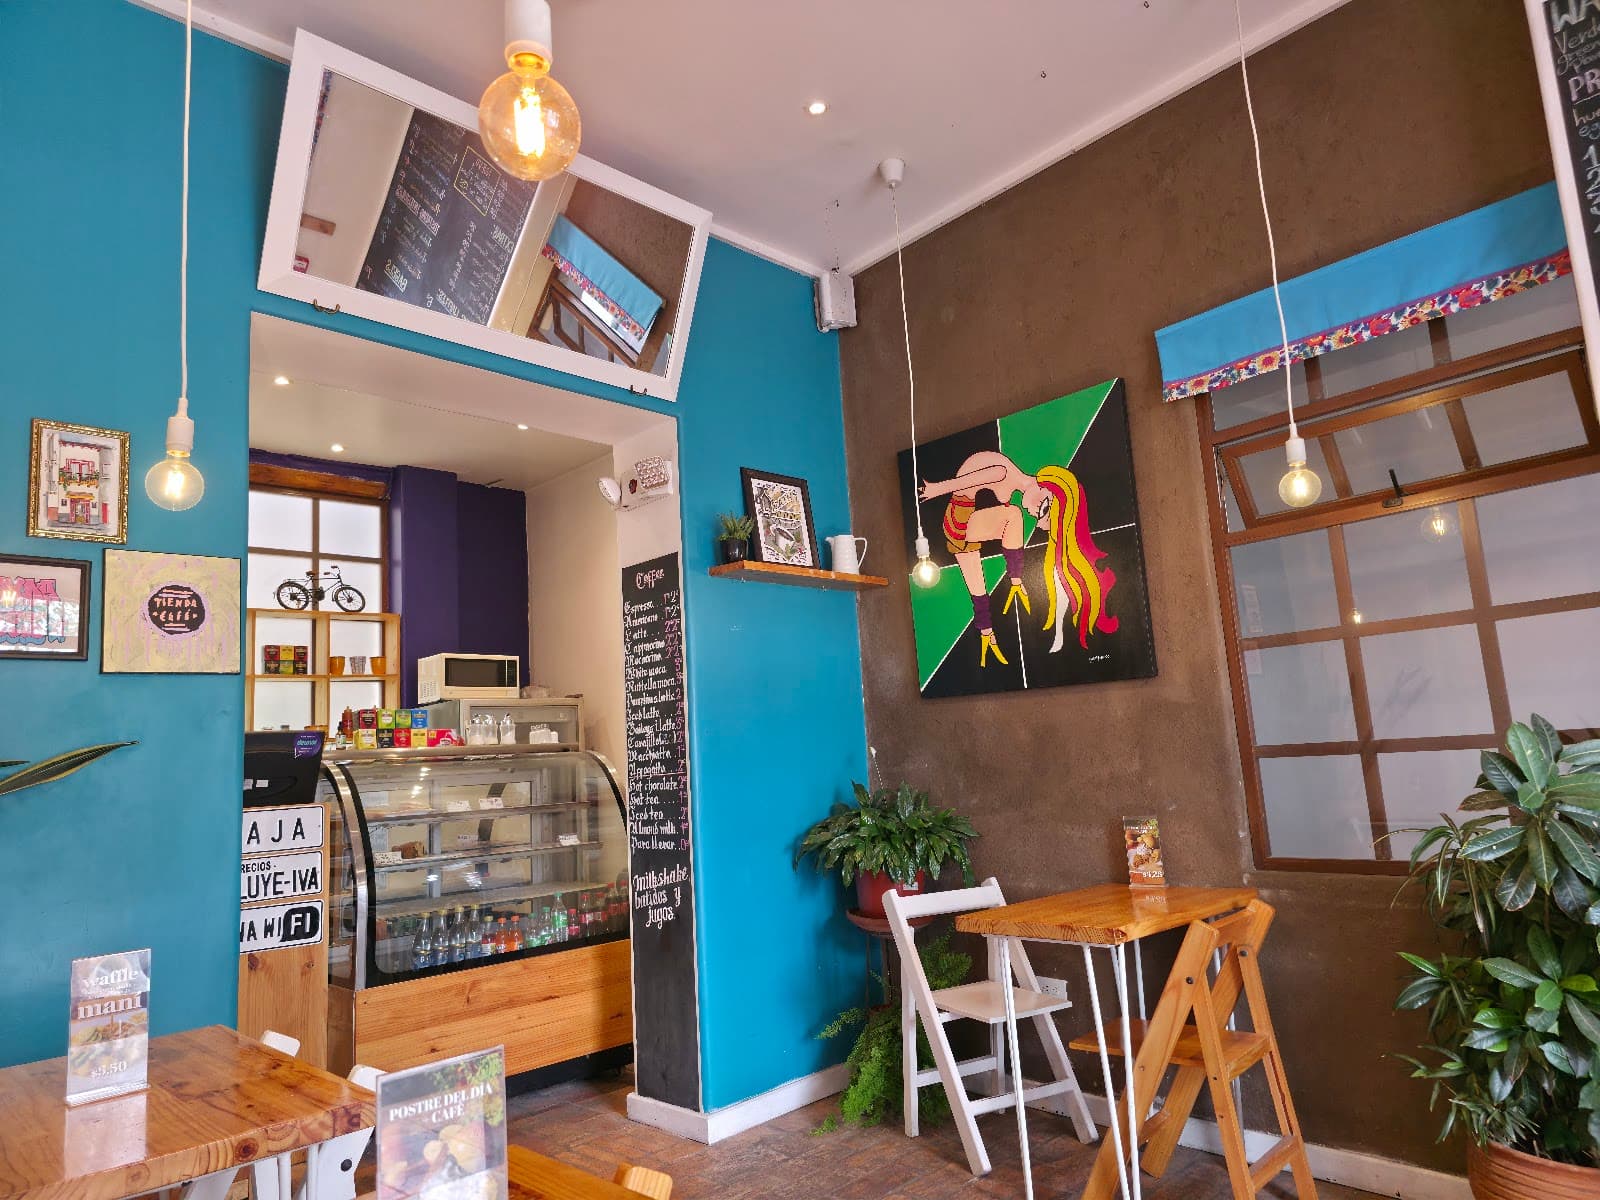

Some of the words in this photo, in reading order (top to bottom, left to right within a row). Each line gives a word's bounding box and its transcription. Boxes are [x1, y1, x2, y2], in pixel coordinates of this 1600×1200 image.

[635, 568, 664, 589] Coffee
[241, 866, 319, 899] UYE-IVA
[634, 888, 668, 909] batidos
[674, 886, 682, 907] y
[388, 1095, 443, 1122] POSTRE
[443, 1089, 469, 1107] DEL
